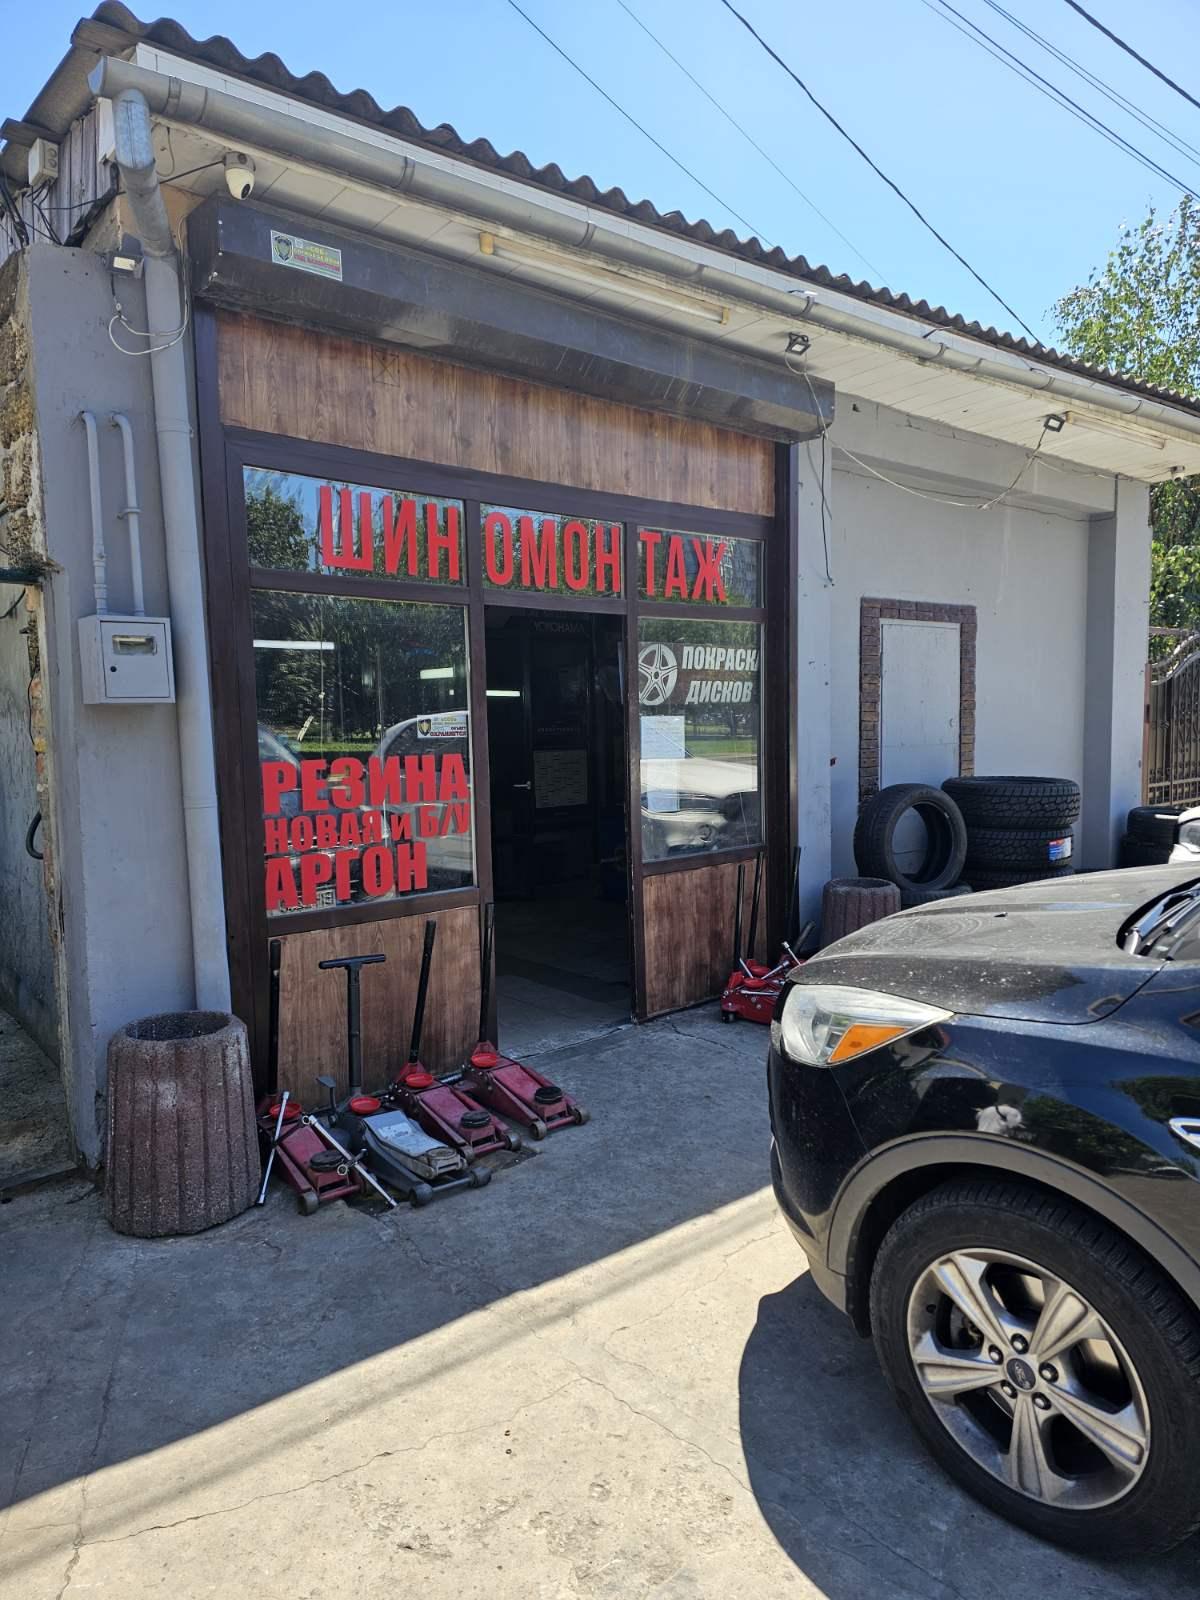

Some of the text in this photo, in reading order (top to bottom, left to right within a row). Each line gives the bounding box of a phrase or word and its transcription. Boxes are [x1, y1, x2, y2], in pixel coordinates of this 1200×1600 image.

[685, 680, 753, 705] ДИСКОВ
[262, 753, 470, 815] РЕЗИНА
[265, 811, 383, 854] НОВАЯ
[265, 841, 428, 911] АРГОН
